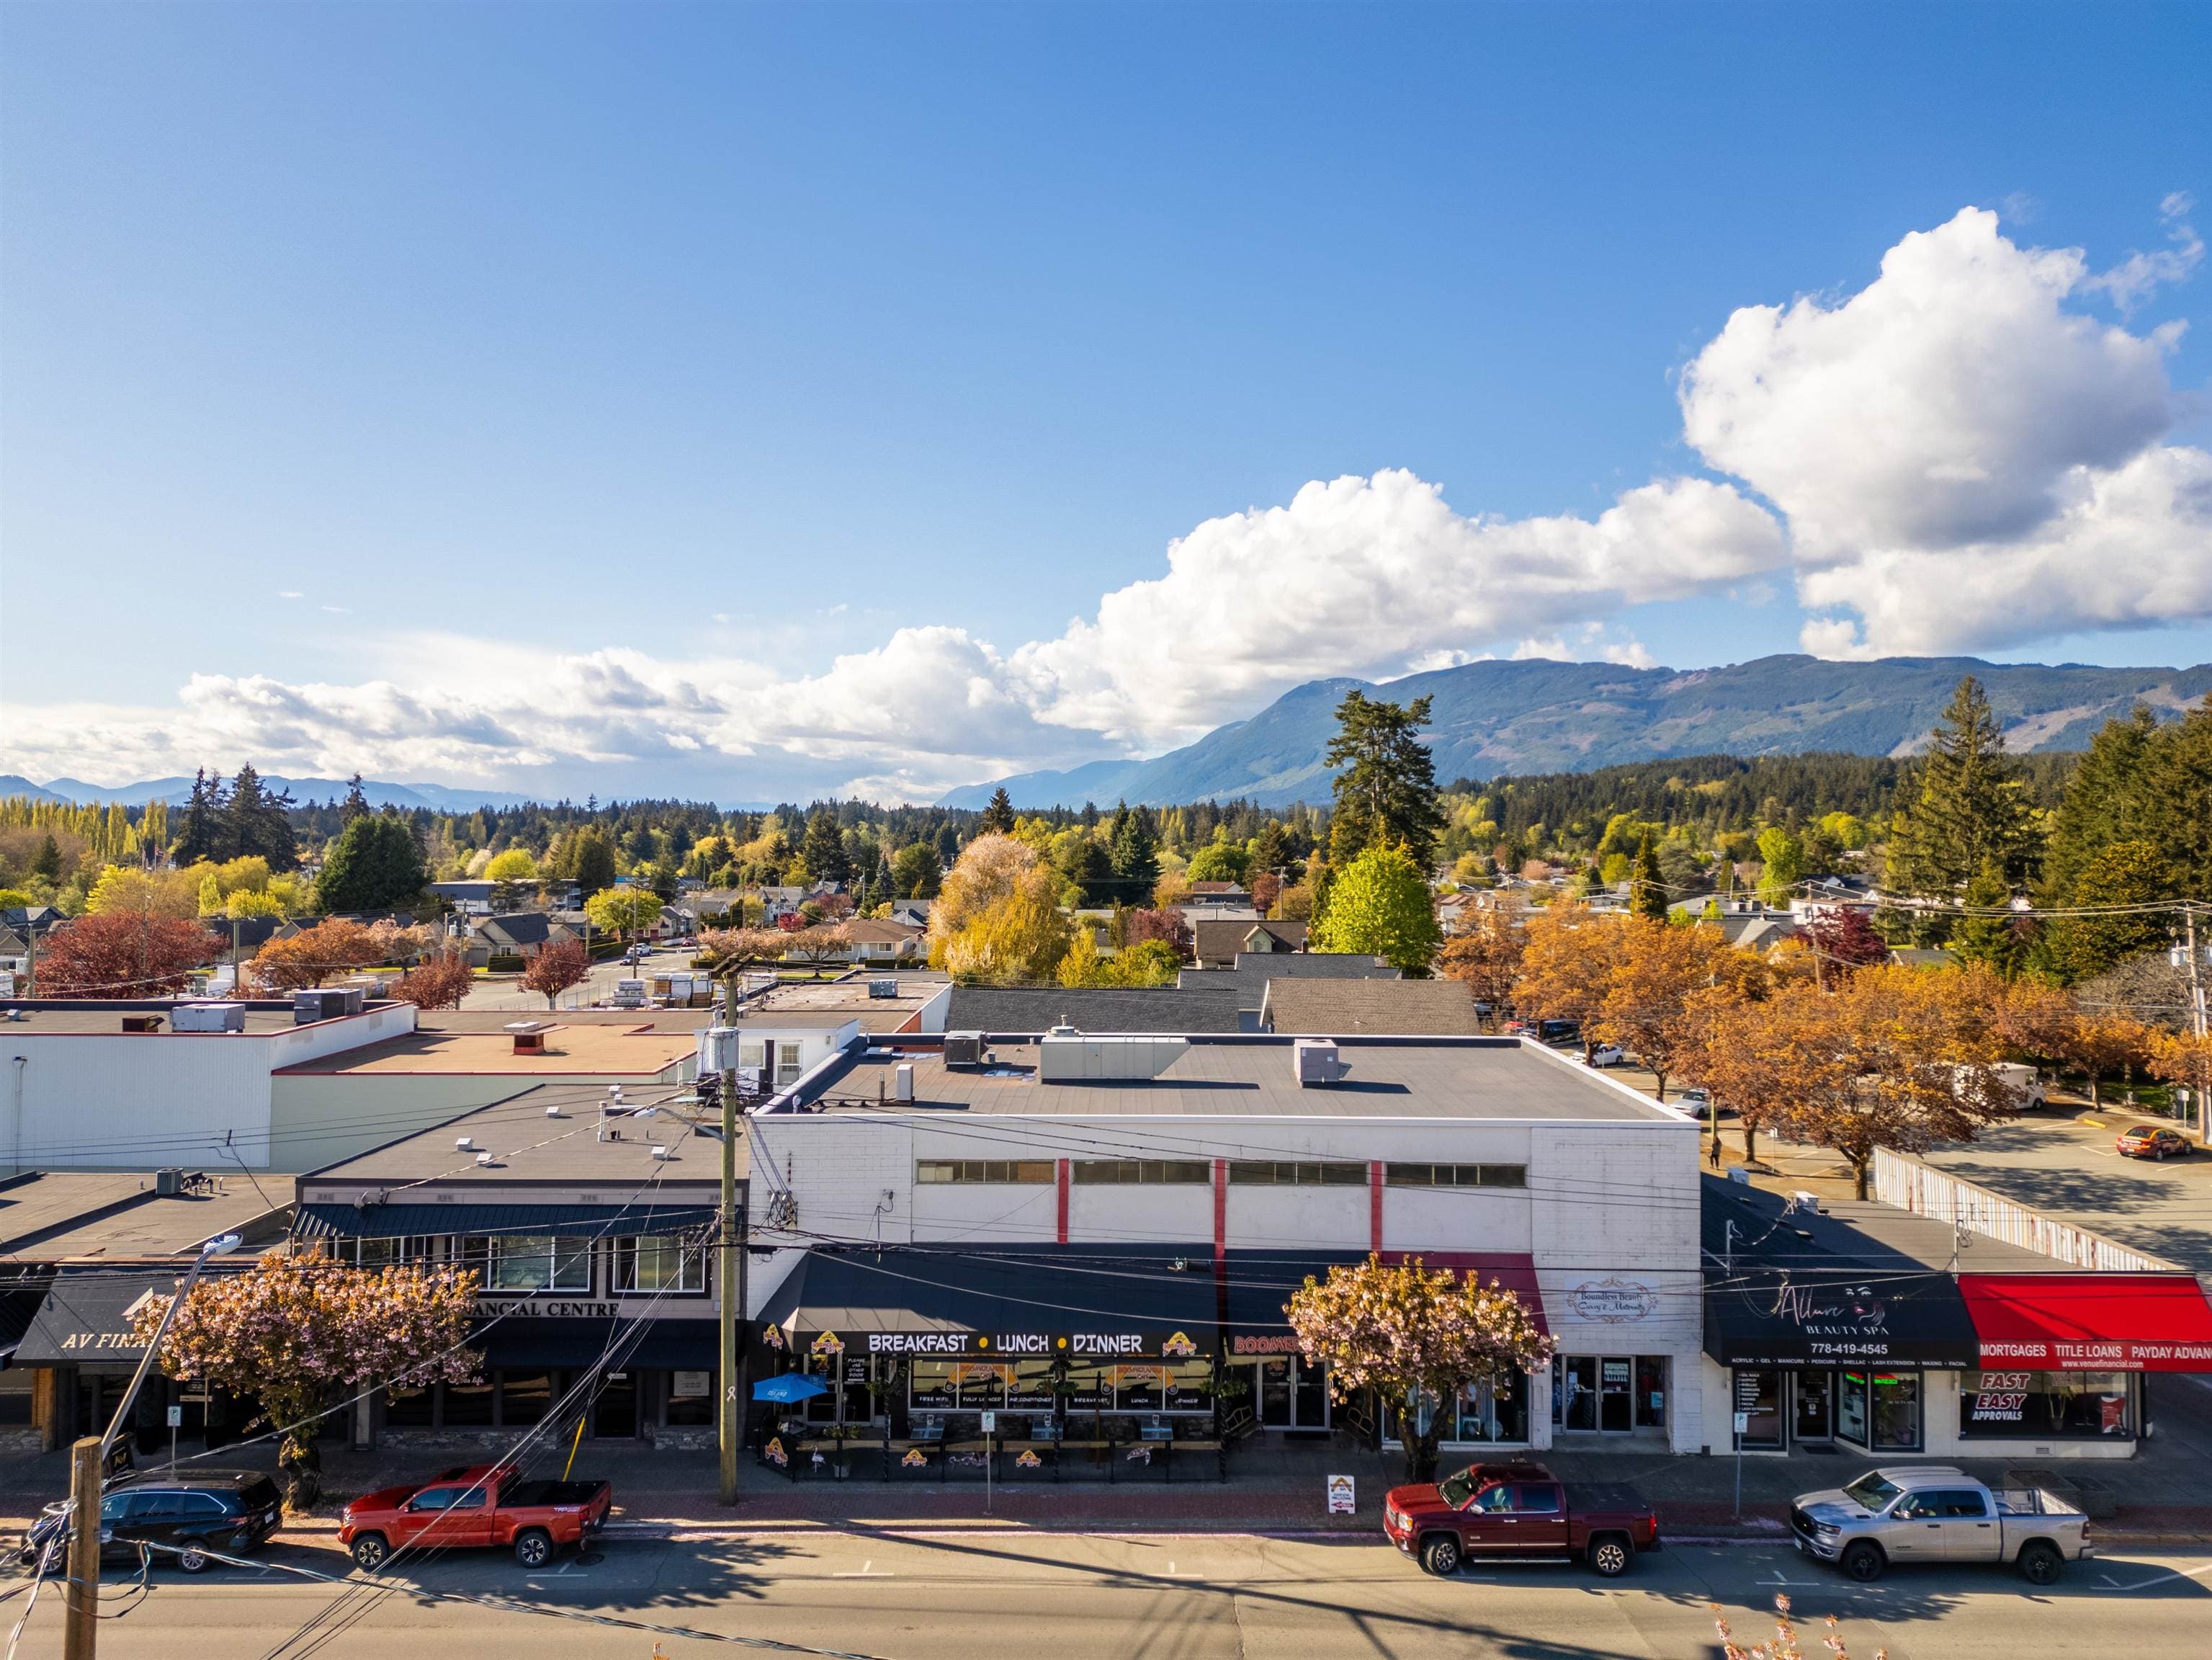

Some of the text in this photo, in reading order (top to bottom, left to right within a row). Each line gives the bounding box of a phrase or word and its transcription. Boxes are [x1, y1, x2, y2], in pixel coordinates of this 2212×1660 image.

[547, 1303, 619, 1316] CENTRE
[1806, 1326, 1889, 1335] BEAUTY SPA
[61, 1334, 153, 1349] AV FINA
[869, 1334, 968, 1352] BREAKFAST
[997, 1334, 1049, 1352] LUNCH
[1073, 1334, 1142, 1353] DINNER
[1811, 1343, 1888, 1355] 778-419-4545
[1980, 1344, 2212, 1360] MORTGAGES TITLE LOANS PAYDAY ADVAN
[2061, 1359, 2144, 1368] www.venuefinancial.com
[1981, 1373, 2030, 1390] FAST
[1976, 1393, 2028, 1409] EASY
[1972, 1411, 2023, 1420] APPROVALS
